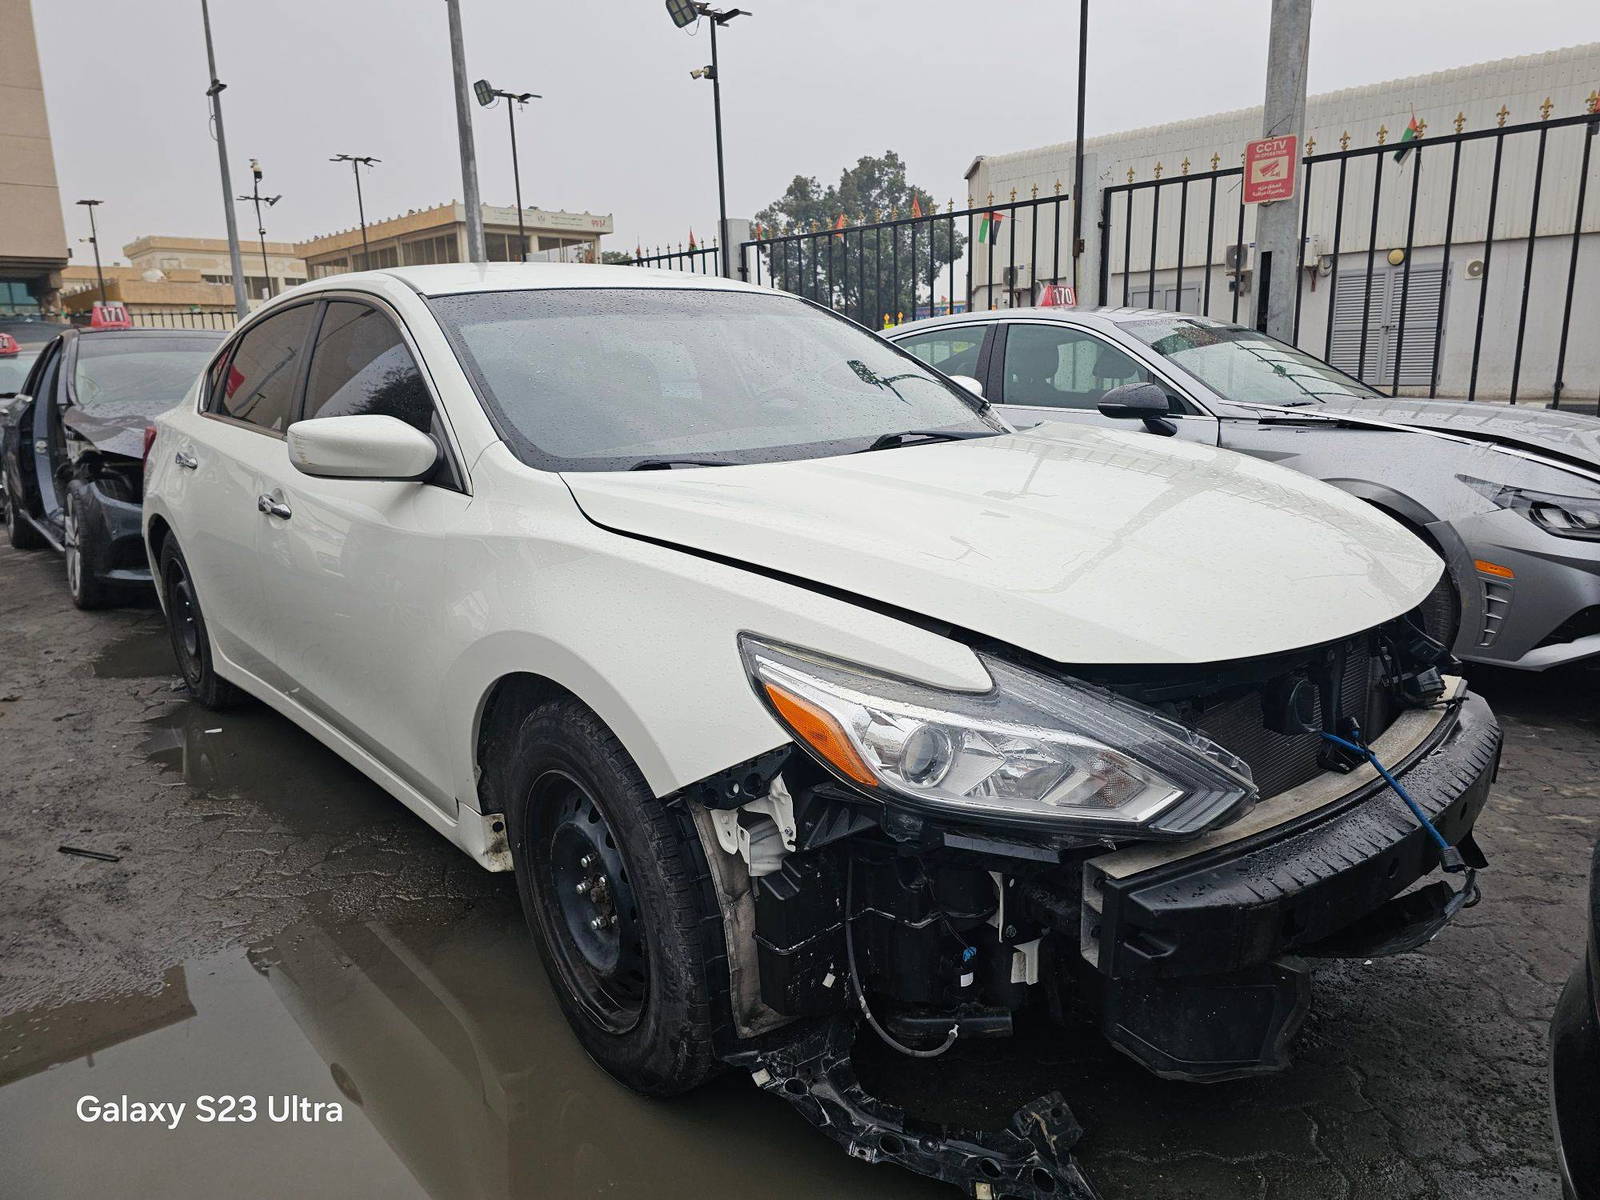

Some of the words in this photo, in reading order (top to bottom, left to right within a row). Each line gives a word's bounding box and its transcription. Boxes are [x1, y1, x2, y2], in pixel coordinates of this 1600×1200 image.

[1256, 140, 1287, 153] CCTV
[1054, 287, 1073, 305] 170
[102, 307, 124, 322] 171
